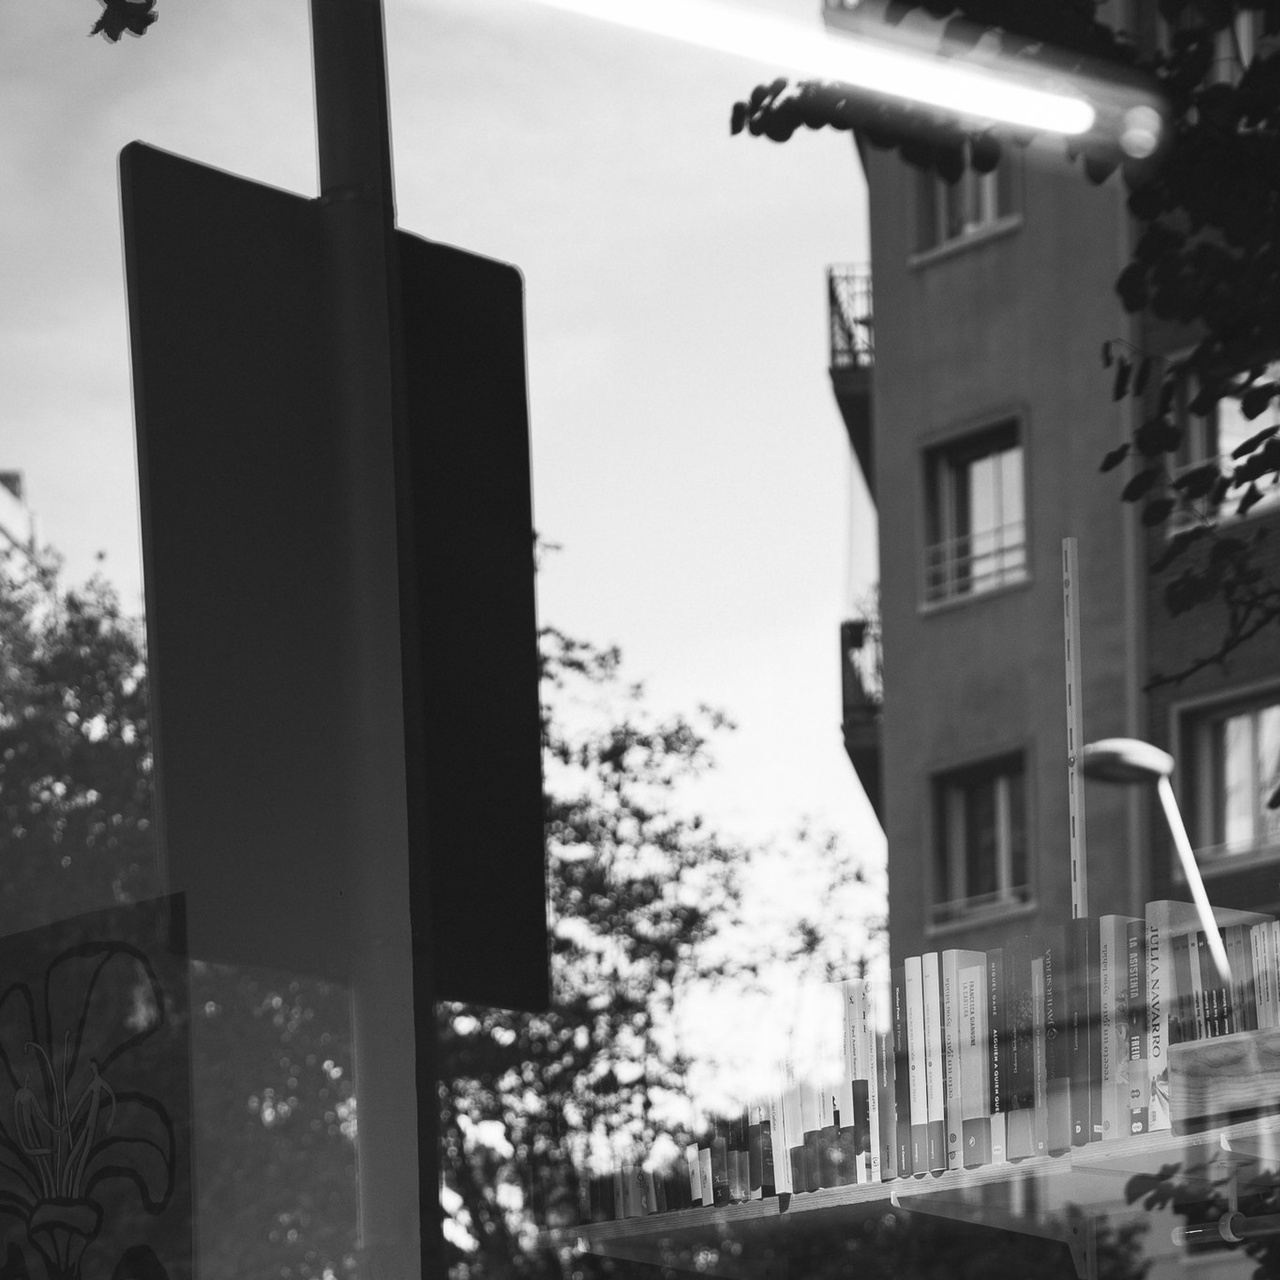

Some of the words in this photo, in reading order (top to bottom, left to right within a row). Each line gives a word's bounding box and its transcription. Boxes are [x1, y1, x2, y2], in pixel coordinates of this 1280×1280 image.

[1129, 937, 1138, 949] LA
[1150, 926, 1160, 972] JULIA
[1129, 953, 1139, 999] ASISTENTA
[1150, 979, 1161, 1058] NAVARRO
